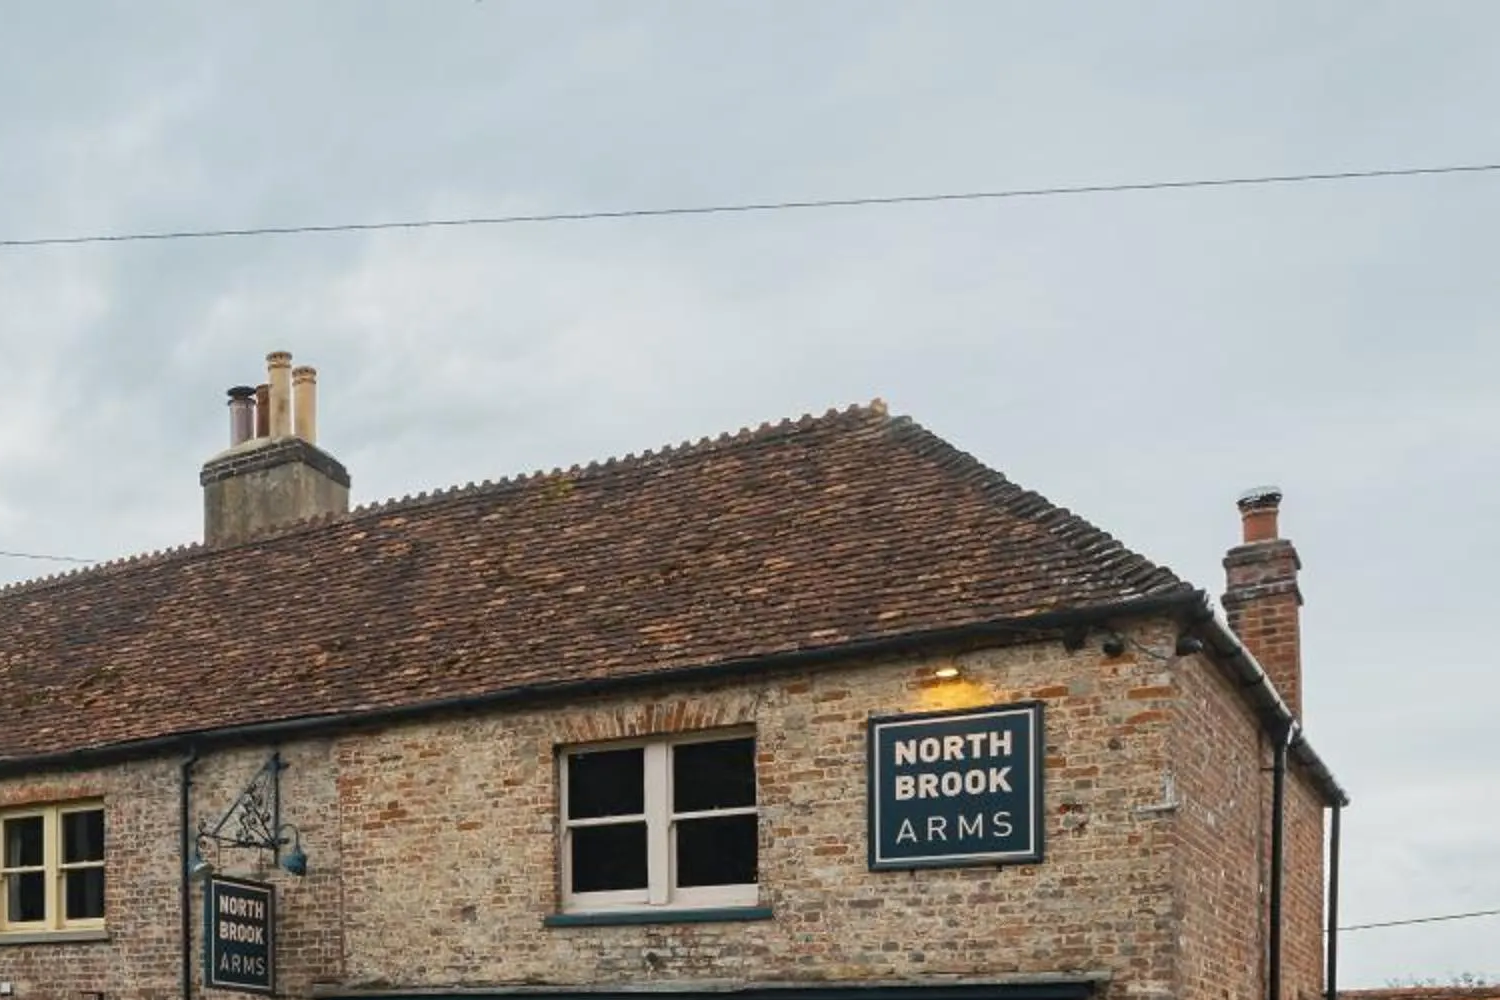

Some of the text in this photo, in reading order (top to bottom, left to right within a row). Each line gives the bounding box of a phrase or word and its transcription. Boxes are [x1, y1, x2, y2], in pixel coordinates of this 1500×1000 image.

[895, 730, 1012, 765] NORTH
[895, 767, 1012, 800] BROOK
[896, 811, 1013, 844] ARMS
[219, 895, 264, 919] NORTH
[219, 921, 264, 944] BROOK
[220, 951, 265, 976] ARMS
